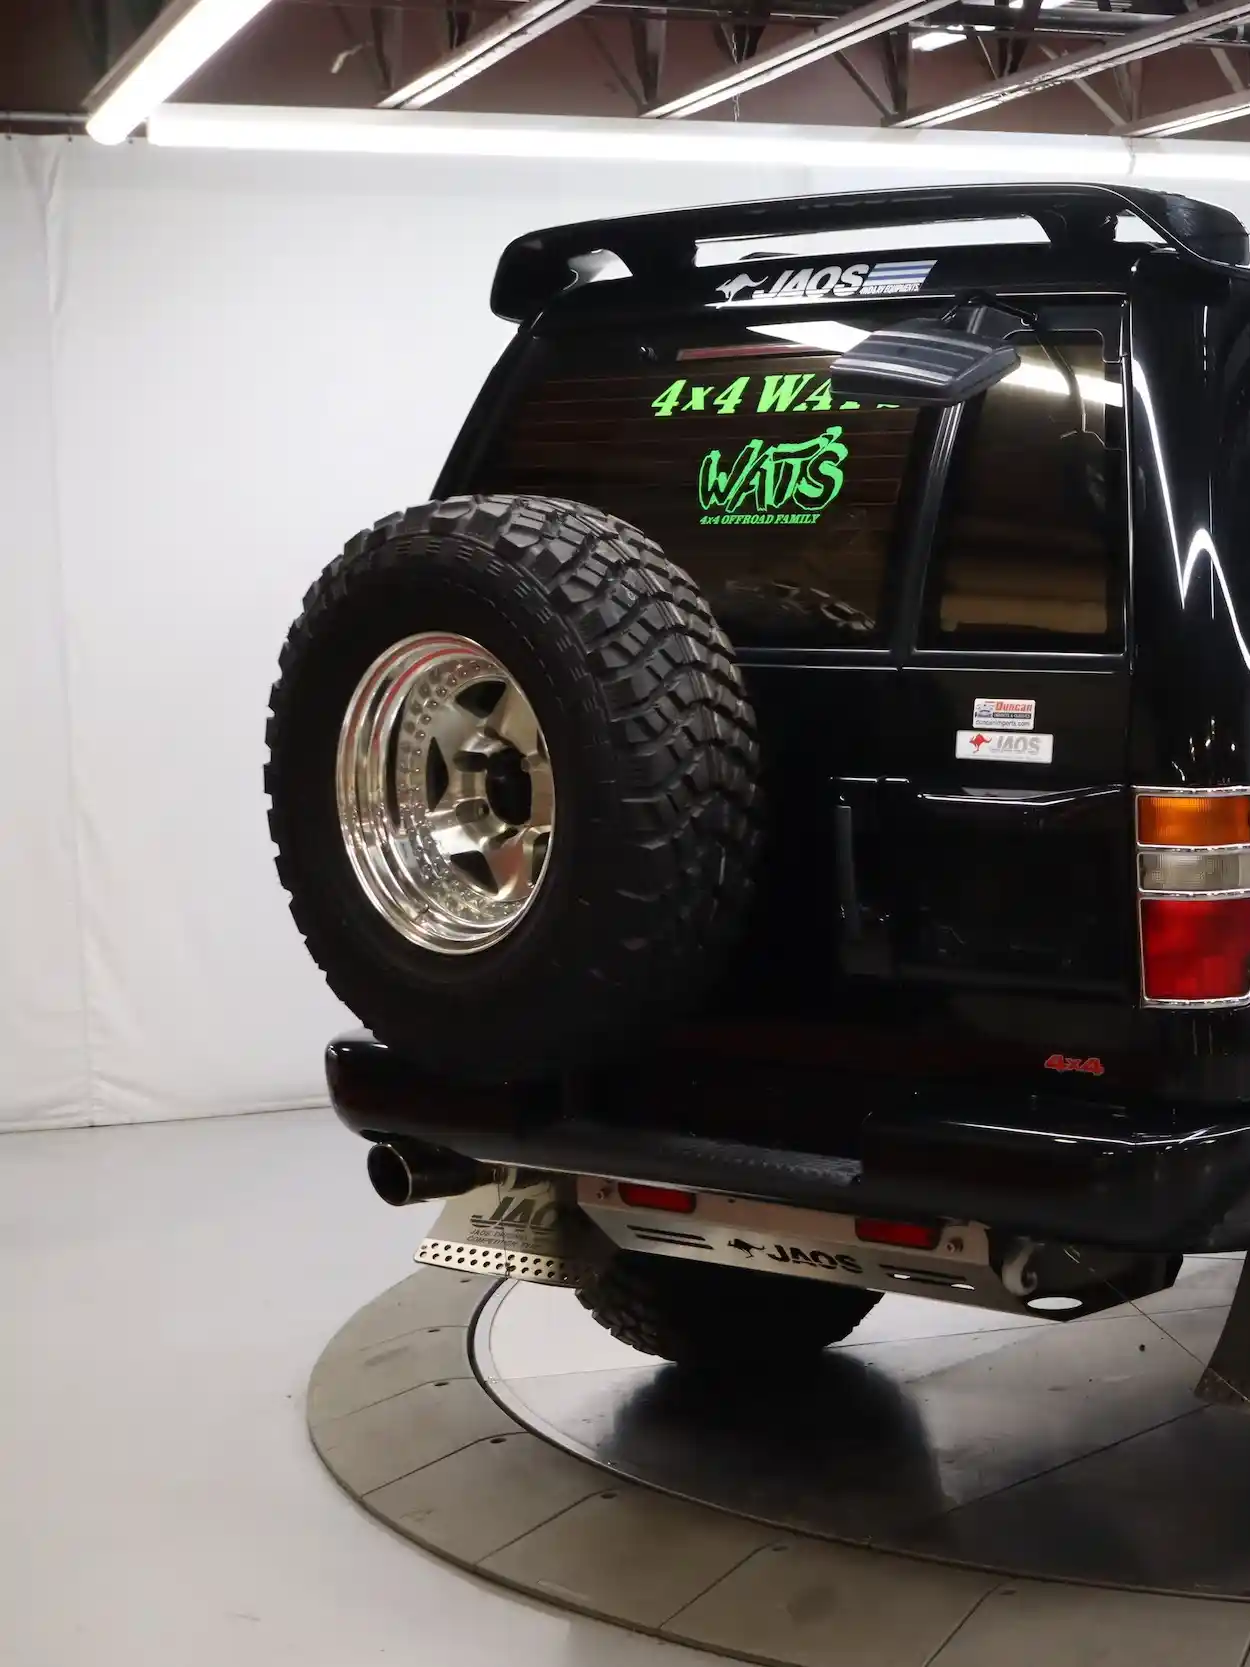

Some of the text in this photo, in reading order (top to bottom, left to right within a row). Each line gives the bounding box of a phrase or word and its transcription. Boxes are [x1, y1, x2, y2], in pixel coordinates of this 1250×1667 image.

[752, 263, 870, 299] JAOS
[651, 373, 900, 417] 4x4 WA
[700, 513, 820, 525] 4x4 OFFROAD FAMILY
[995, 700, 1033, 712] Duncan
[989, 735, 1042, 755] JAOS
[1044, 1054, 1105, 1076] 4x4
[470, 1196, 565, 1235] JAO
[768, 1244, 863, 1274] JAOS
